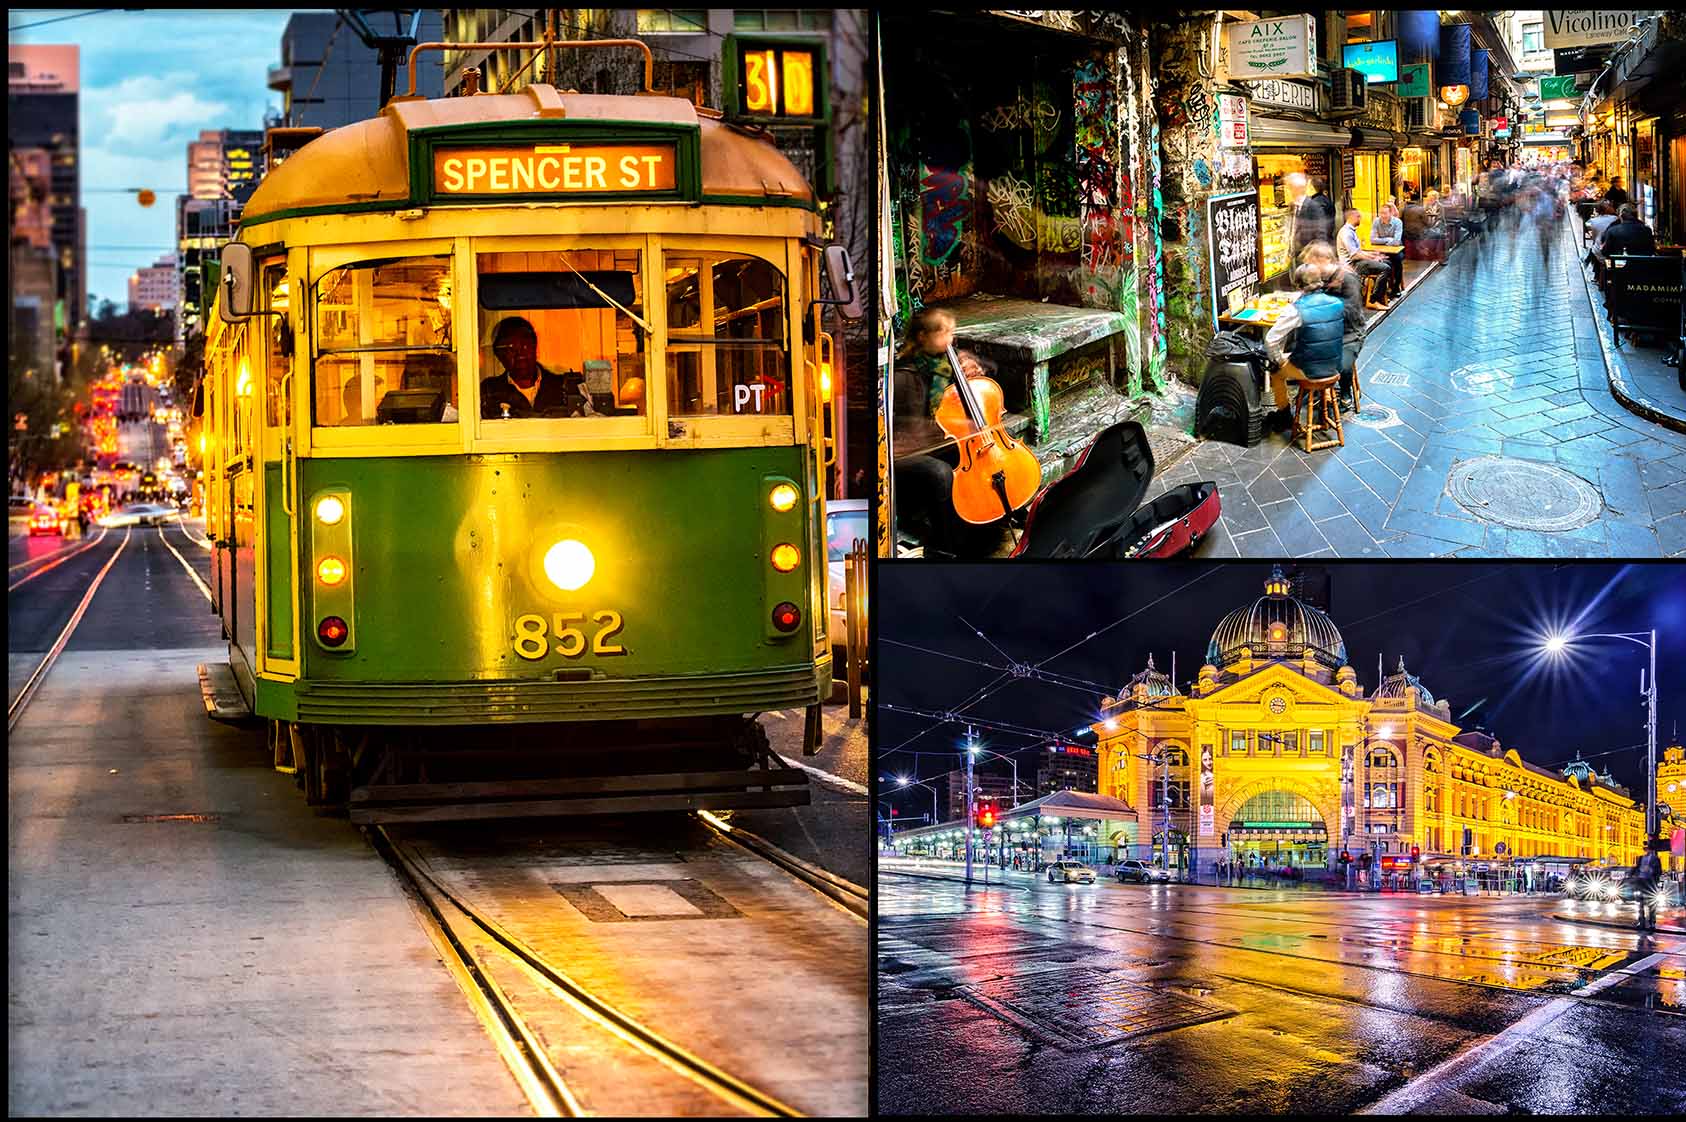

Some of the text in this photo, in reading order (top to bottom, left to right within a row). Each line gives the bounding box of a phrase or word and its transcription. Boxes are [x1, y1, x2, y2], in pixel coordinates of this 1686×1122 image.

[1251, 22, 1283, 38] AIX
[1548, 10, 1629, 35] Vicolino
[744, 53, 809, 113] 30
[443, 155, 662, 191] SPENCER ST
[514, 609, 627, 661] 852
